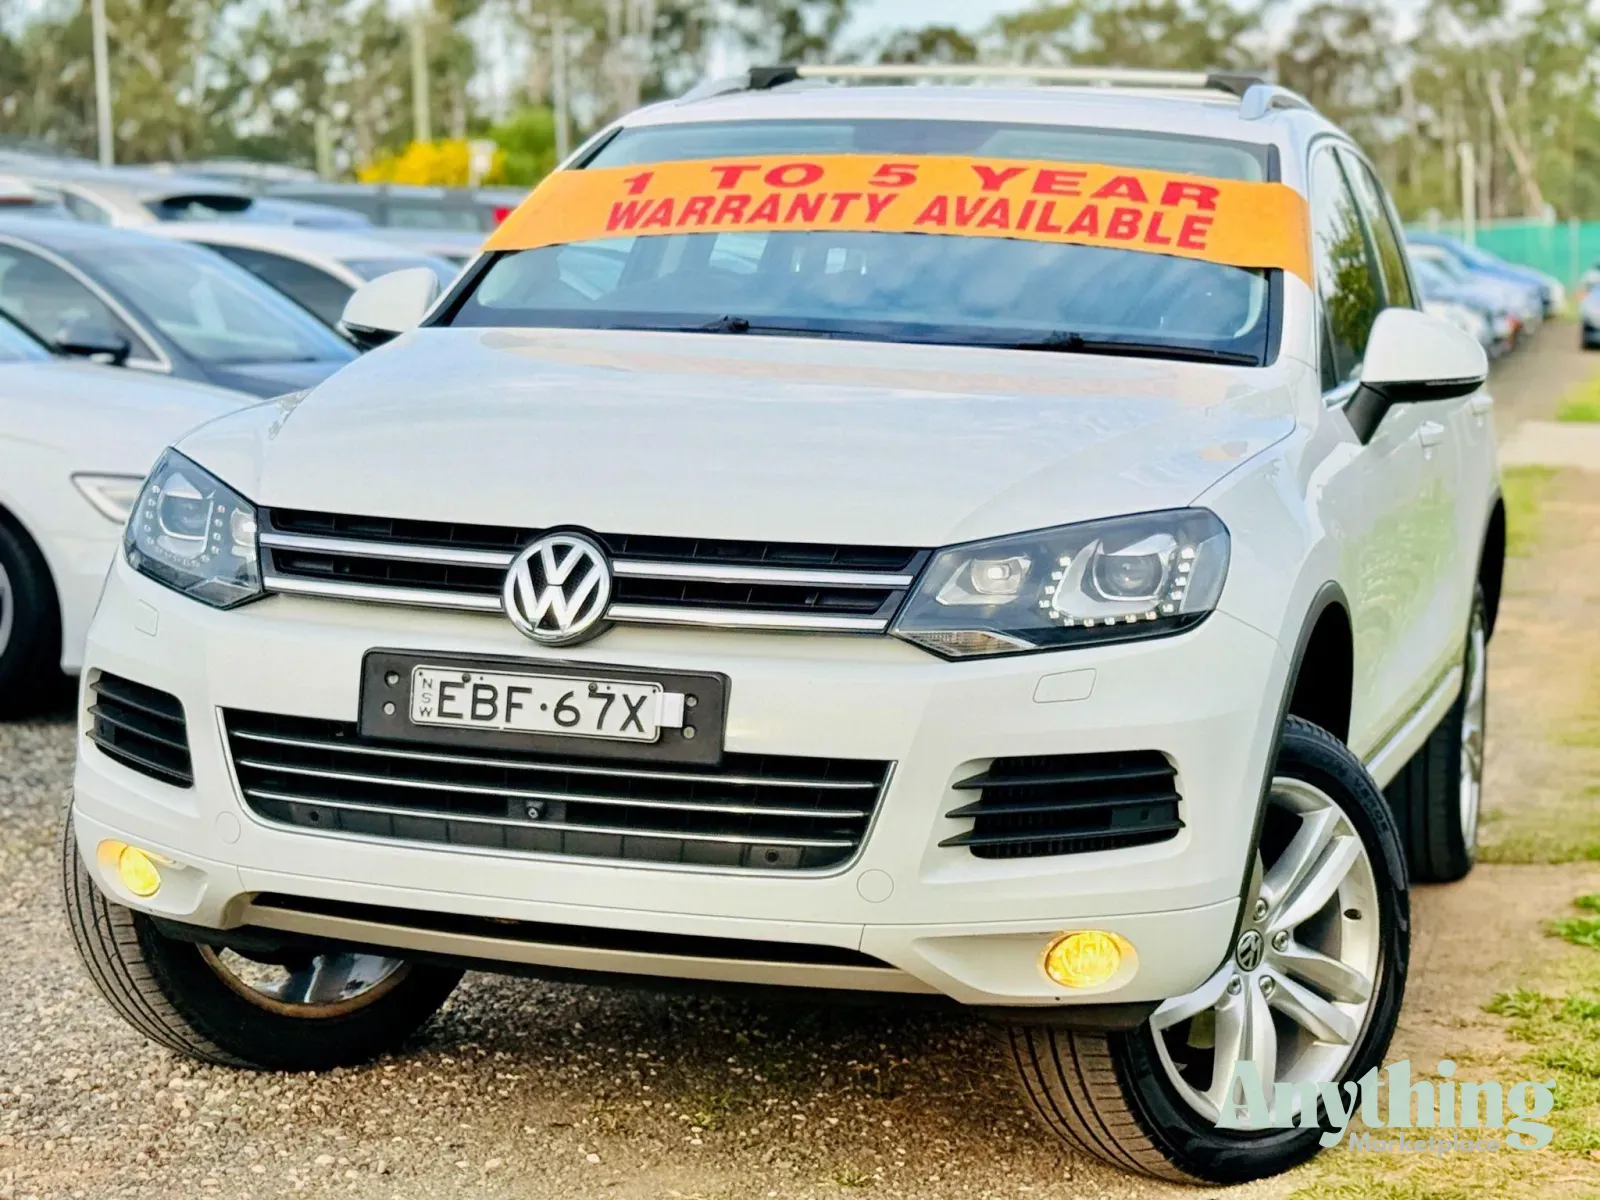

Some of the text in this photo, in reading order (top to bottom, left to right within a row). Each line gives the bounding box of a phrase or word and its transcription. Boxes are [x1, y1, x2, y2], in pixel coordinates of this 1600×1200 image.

[623, 162, 1222, 212] 1 TO 5 YEAR
[605, 192, 1215, 251] WARRANTY AVAILABLE
[504, 536, 611, 634] VW
